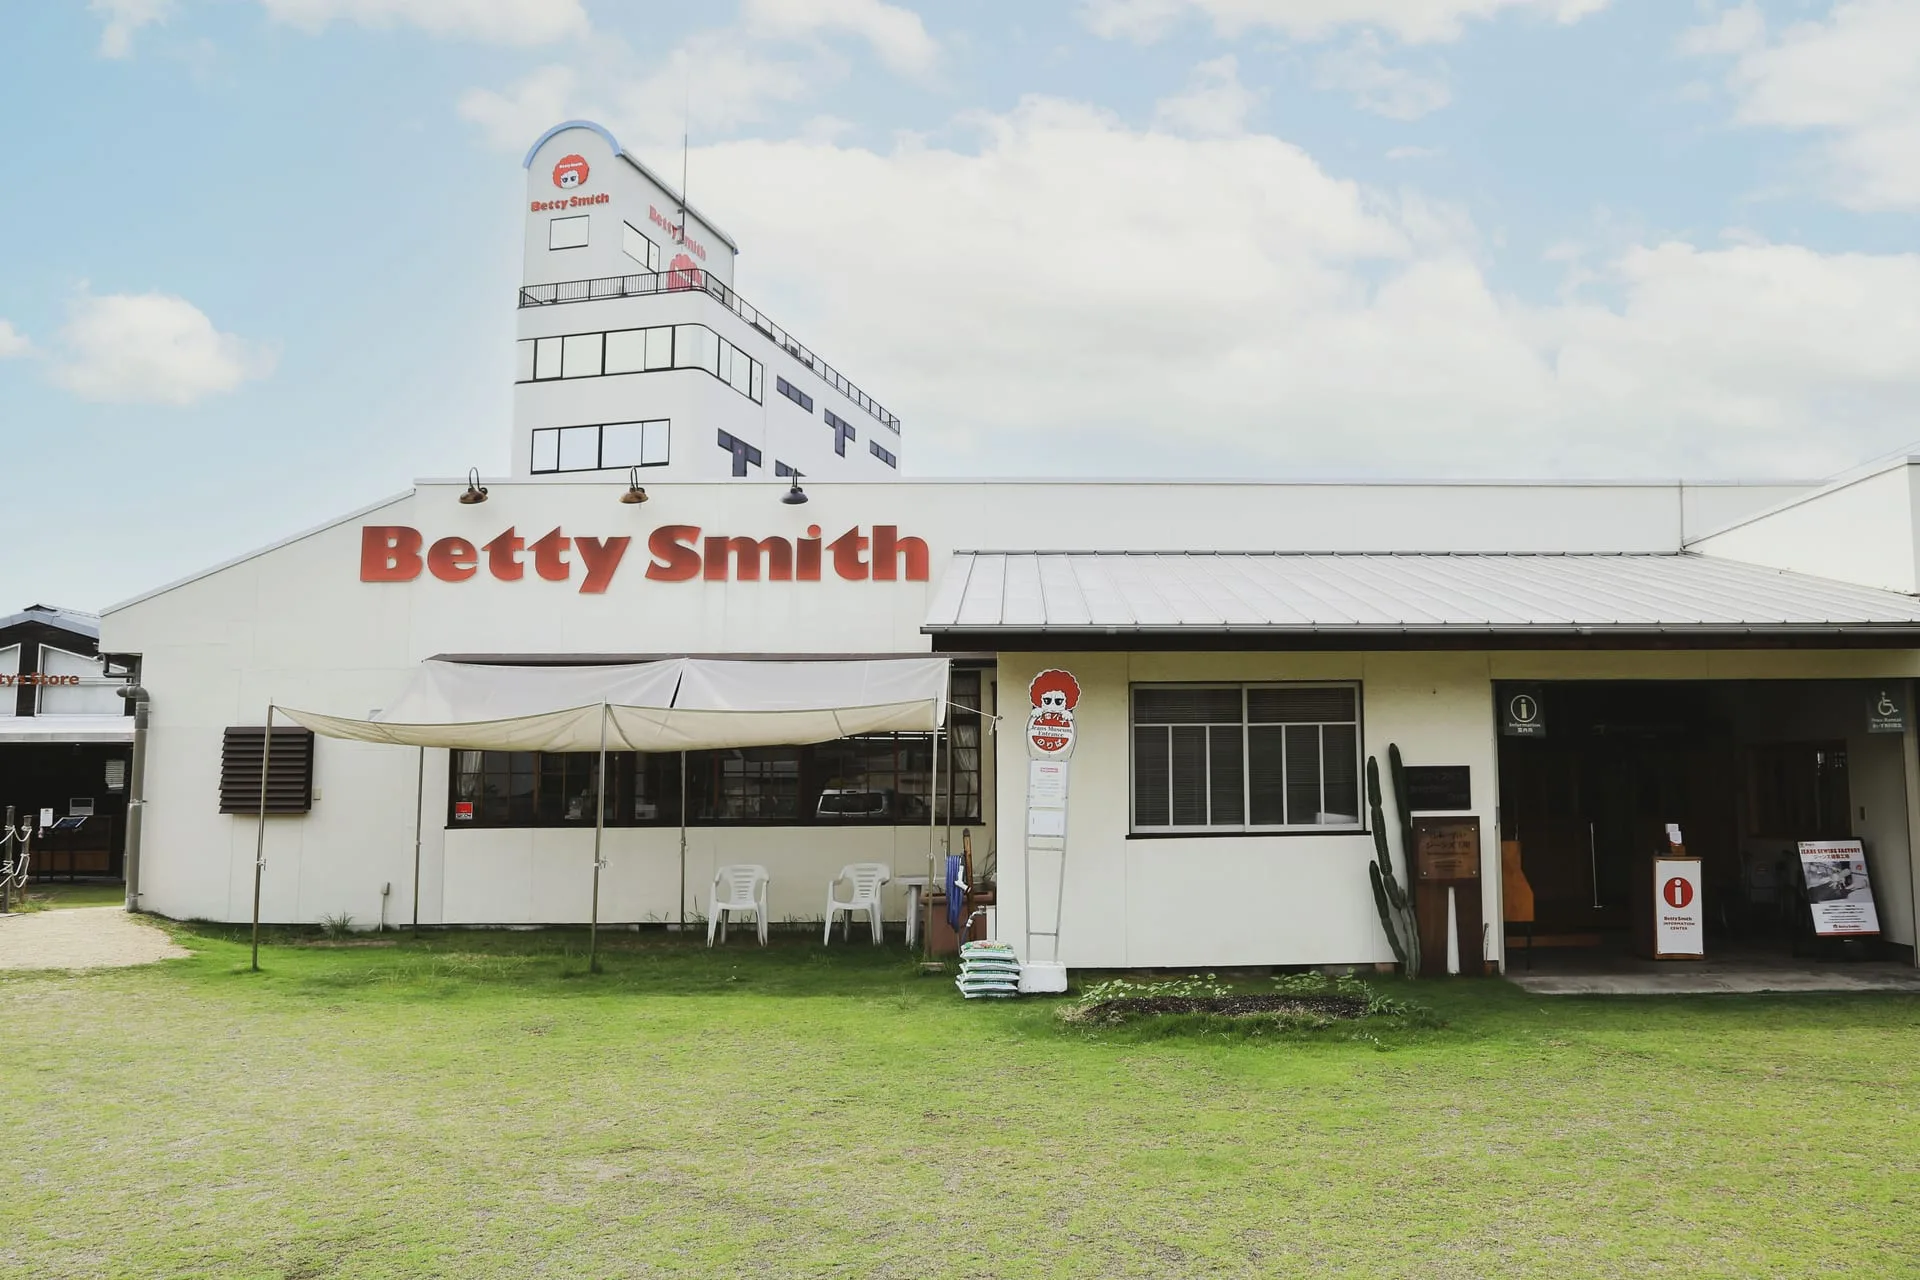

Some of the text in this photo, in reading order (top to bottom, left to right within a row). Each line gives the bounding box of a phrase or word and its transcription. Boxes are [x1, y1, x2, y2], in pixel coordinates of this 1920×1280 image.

[531, 193, 610, 212] Betty Smith
[359, 524, 930, 594] Betty Smith
[31, 672, 79, 686] Store
